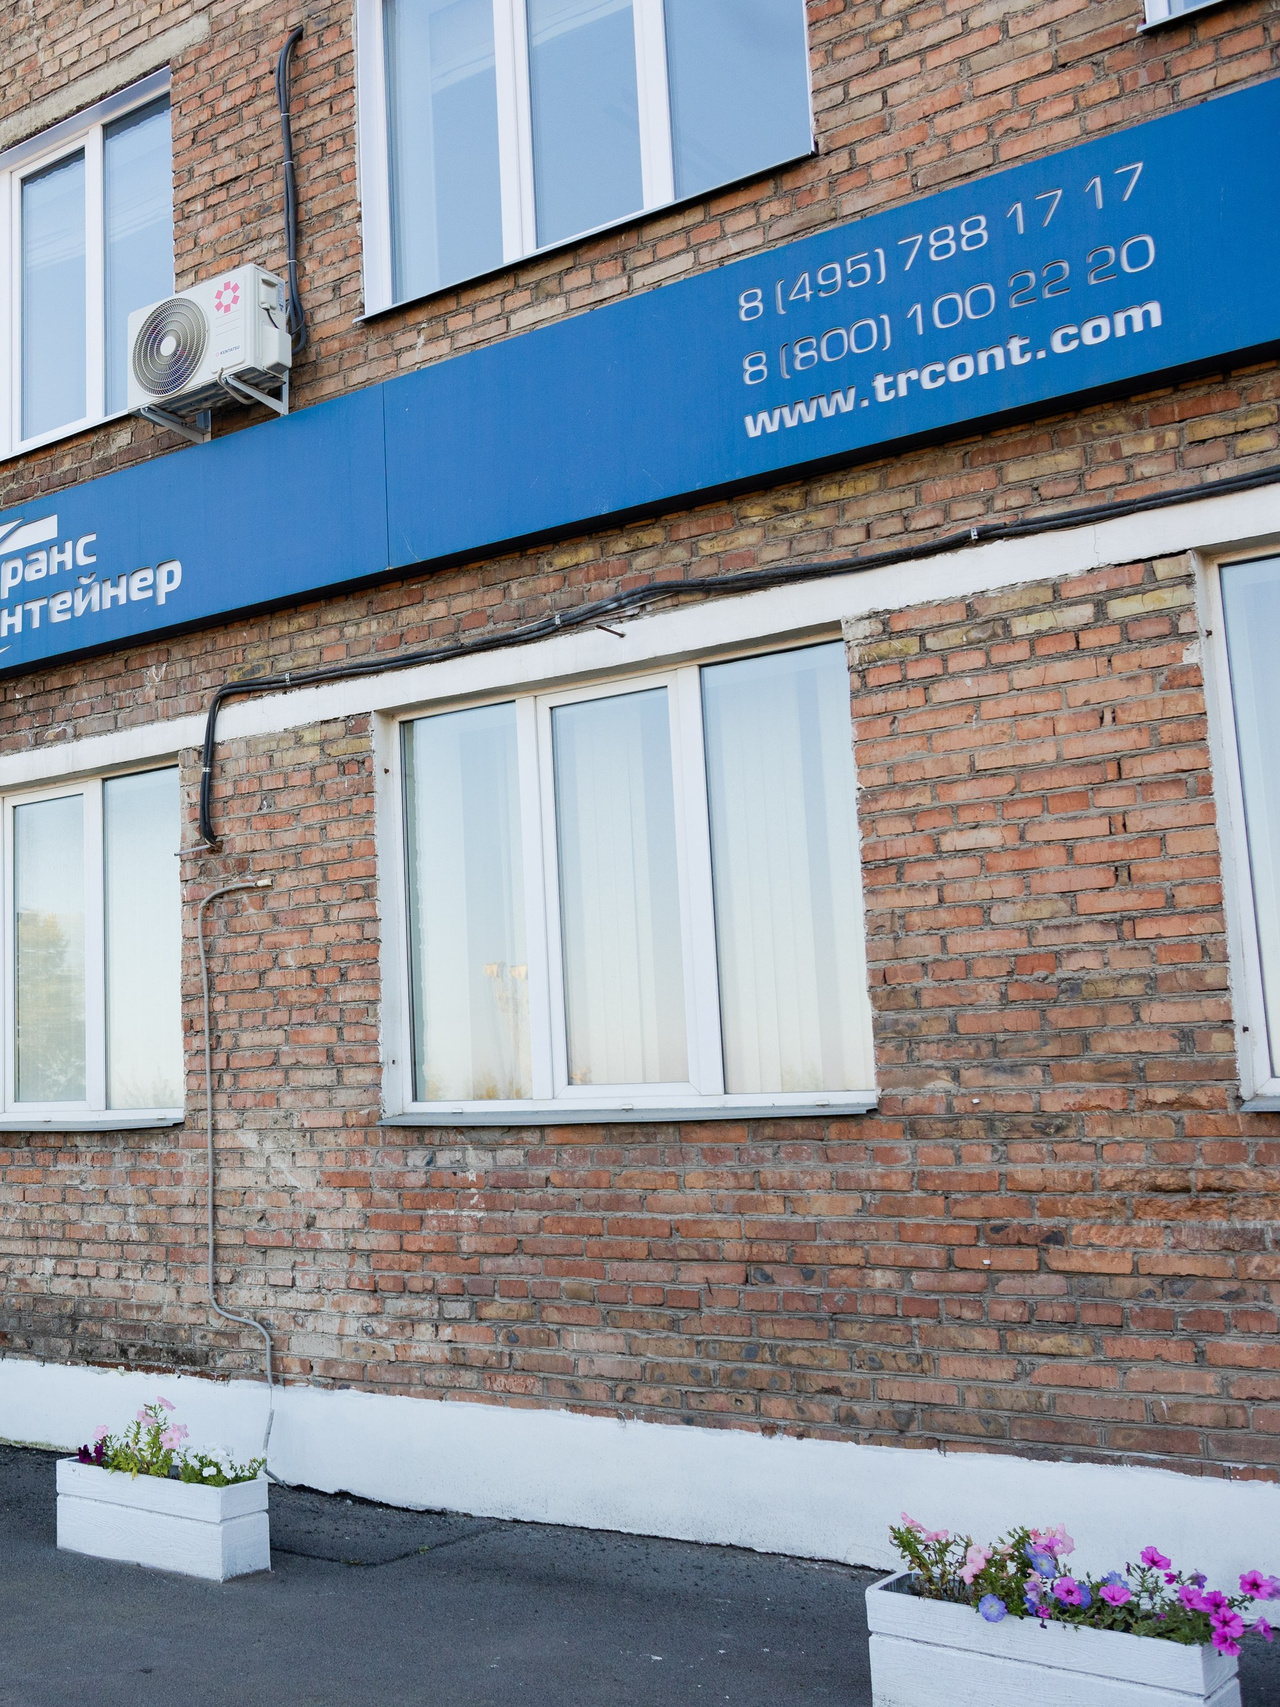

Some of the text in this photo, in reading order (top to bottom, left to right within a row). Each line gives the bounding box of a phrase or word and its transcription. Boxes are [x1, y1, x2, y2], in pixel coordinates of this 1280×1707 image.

[738, 161, 1145, 322] 8 (495) 788 17 17
[742, 234, 1156, 385] 8 (800) 100 22 20
[744, 300, 1163, 438] www.trcont.com
